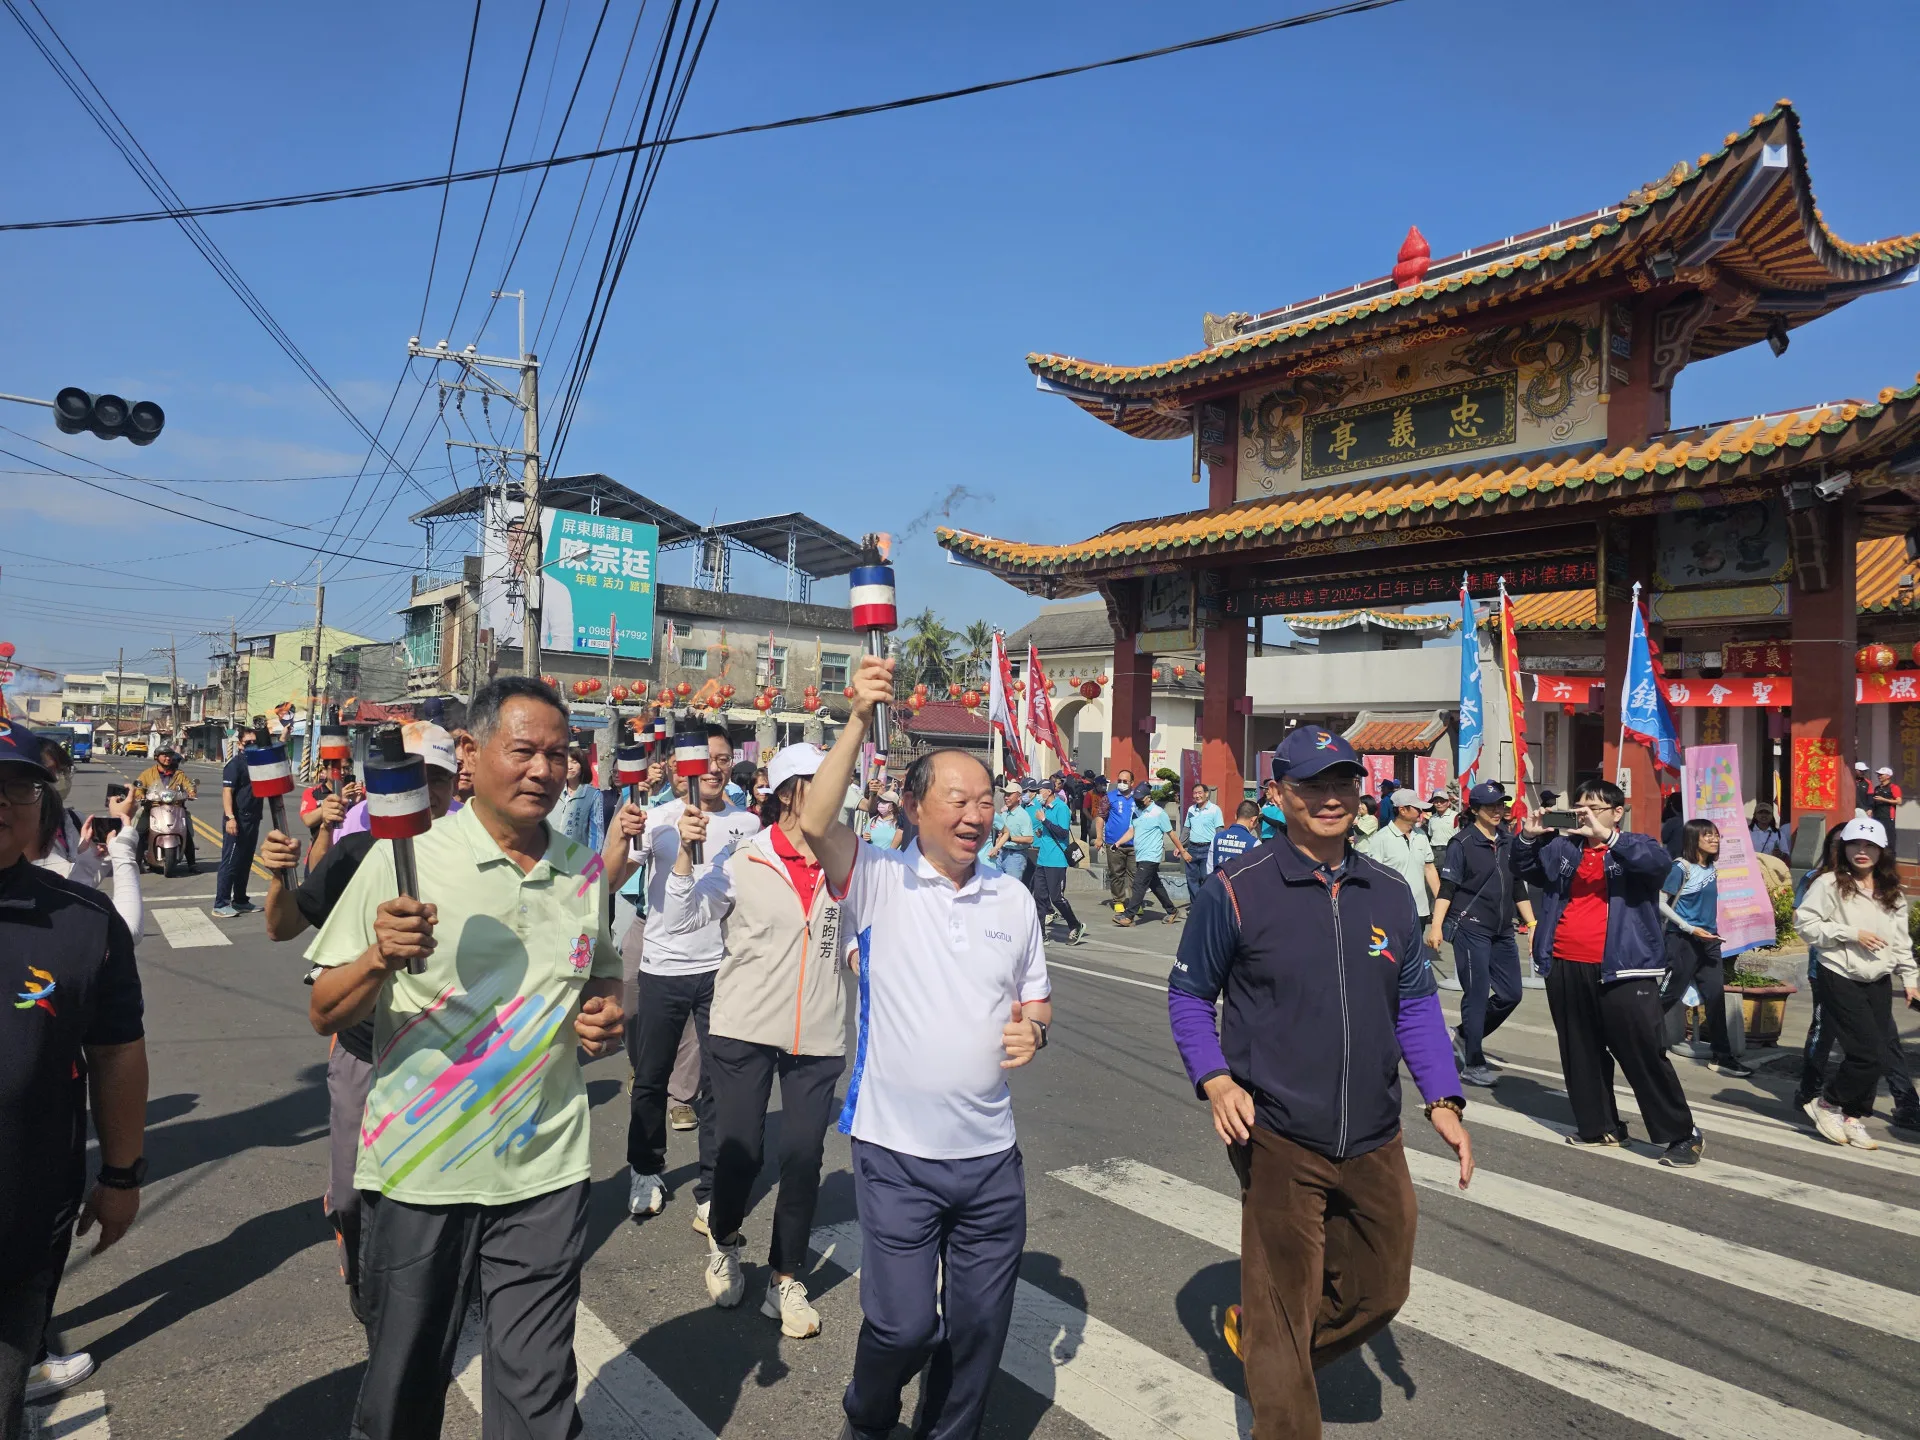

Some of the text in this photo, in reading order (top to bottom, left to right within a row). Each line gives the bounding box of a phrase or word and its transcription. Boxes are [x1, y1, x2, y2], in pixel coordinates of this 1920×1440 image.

[1328, 394, 1485, 461] 忠義亭
[562, 518, 634, 544] 屏東縣議員
[558, 537, 651, 580] 陳宗廷
[575, 573, 651, 594] 年輕 活力 踏實
[820, 906, 838, 958] 李昀芳
